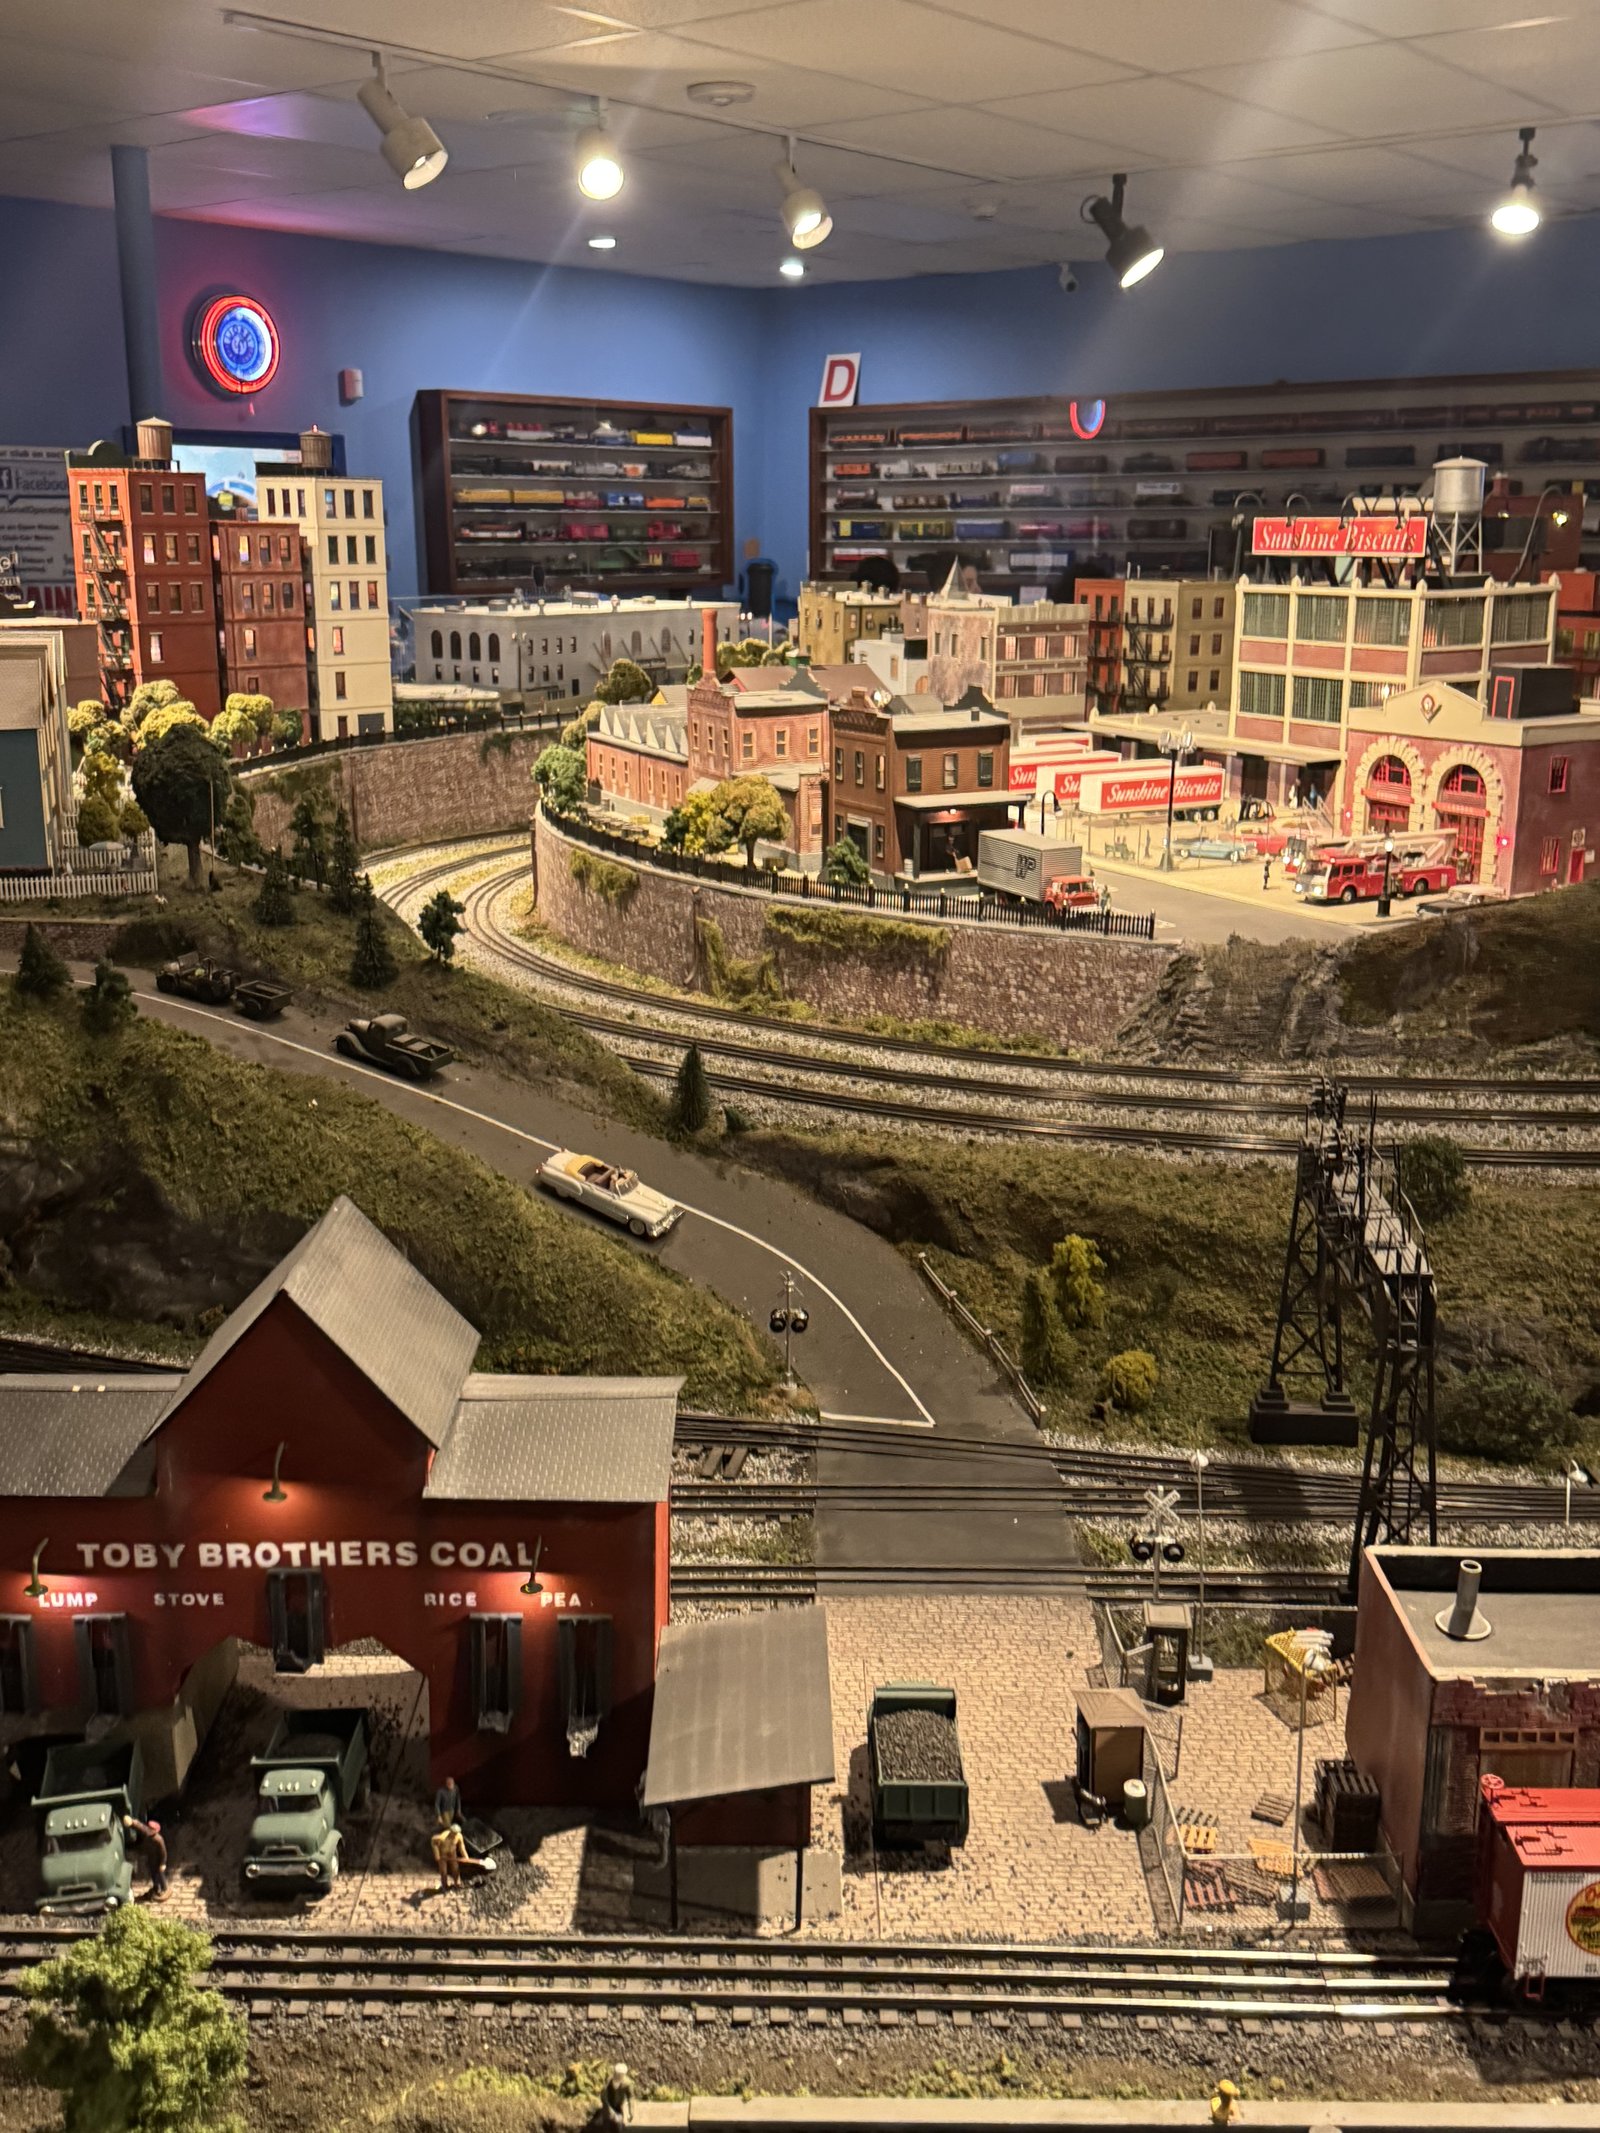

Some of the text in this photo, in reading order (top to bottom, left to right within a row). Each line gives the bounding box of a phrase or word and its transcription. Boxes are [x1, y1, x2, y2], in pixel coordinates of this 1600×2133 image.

[823, 359, 856, 402] D
[1259, 523, 1417, 552] Sunshine Biscuits
[1107, 779, 1221, 804] Sunshine Biscuits
[76, 1541, 533, 1569] TOBY BROTHERS COAL
[38, 1592, 98, 1608] LUMP
[153, 1592, 225, 1607] STOVE
[424, 1592, 478, 1607] RICE
[540, 1592, 582, 1608] PEA
